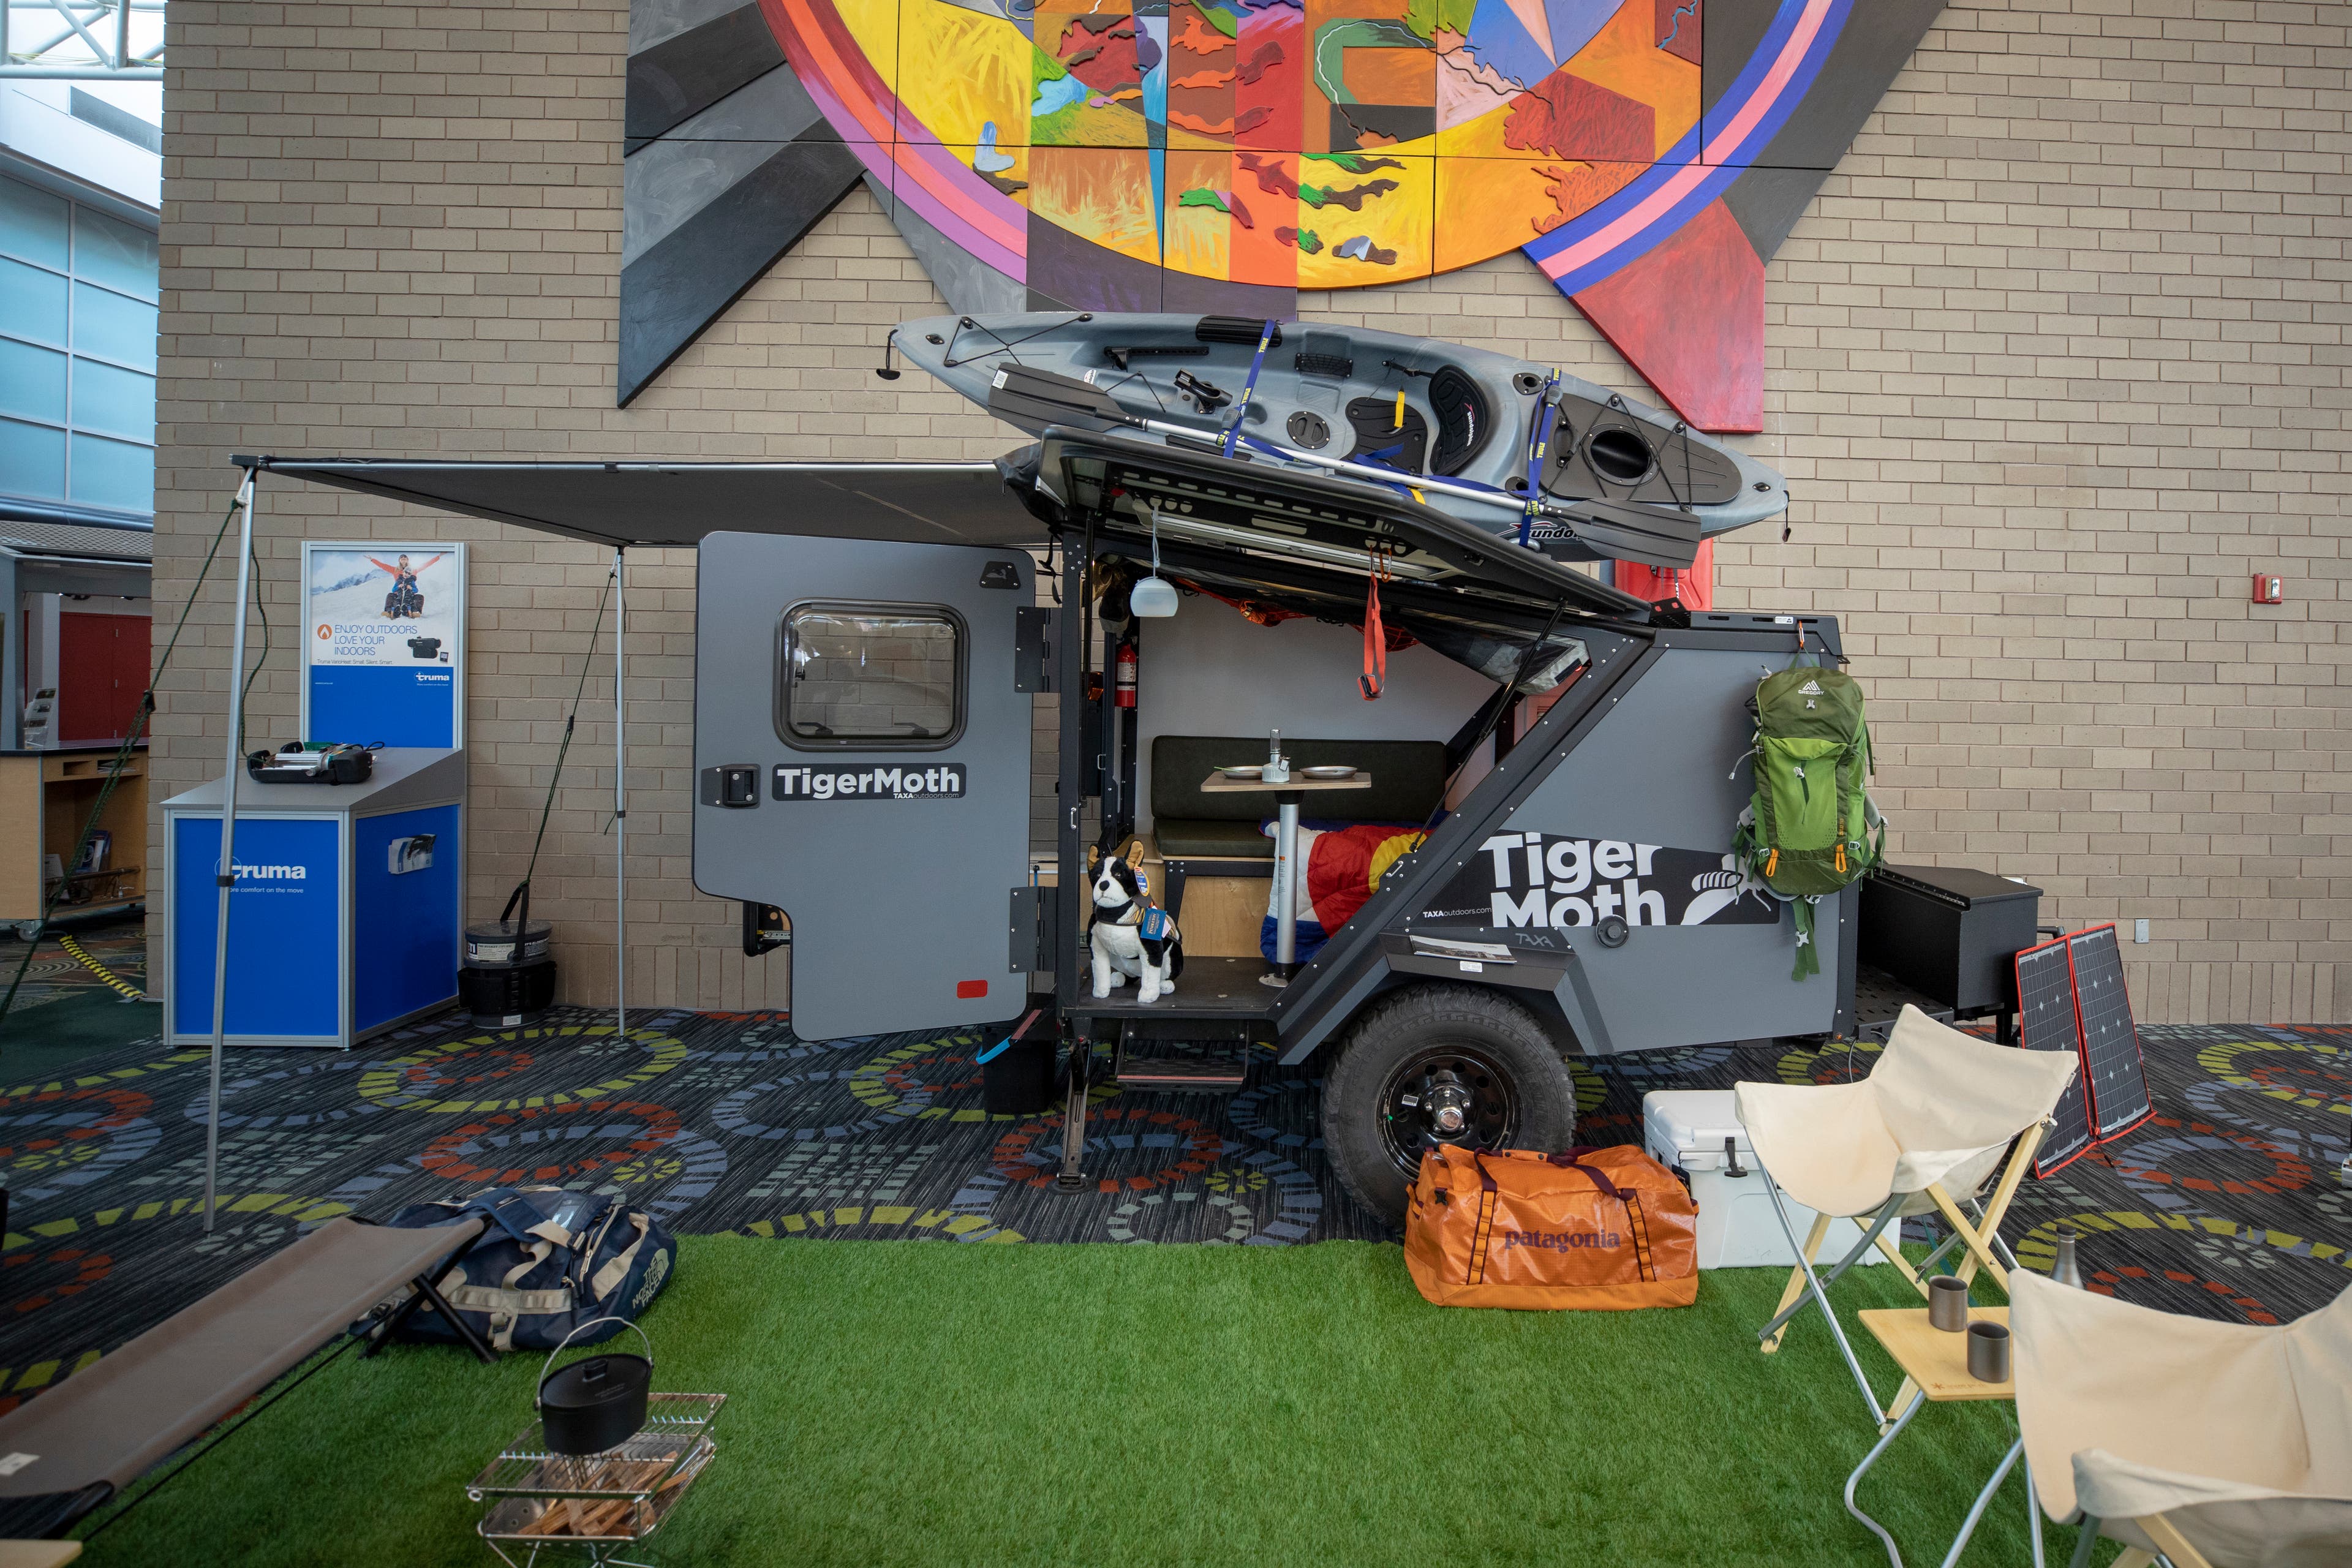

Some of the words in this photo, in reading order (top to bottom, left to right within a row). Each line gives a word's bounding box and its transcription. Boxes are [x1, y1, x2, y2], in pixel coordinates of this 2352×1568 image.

[1257, 337, 1269, 353] THULE
[1241, 387, 1251, 404] THULE
[1536, 442, 1546, 459] THULE
[334, 625, 365, 633] ENJOY
[366, 625, 418, 634] OUTDOORS
[334, 636, 358, 644] LOVE
[359, 636, 385, 645] YOUR
[334, 647, 376, 655] INDOORS
[415, 672, 450, 681] truma
[777, 767, 959, 799] TigerMoth
[1478, 832, 1663, 894] Tiger
[1491, 878, 1667, 927] Moth
[1423, 907, 1492, 918] TAXAoutdoors.com
[1515, 932, 1555, 948] TAXA
[1504, 1229, 1621, 1253] patagonia
[643, 1256, 658, 1282] THE
[632, 1263, 658, 1309] NORTH
[641, 1275, 660, 1308] FACE
